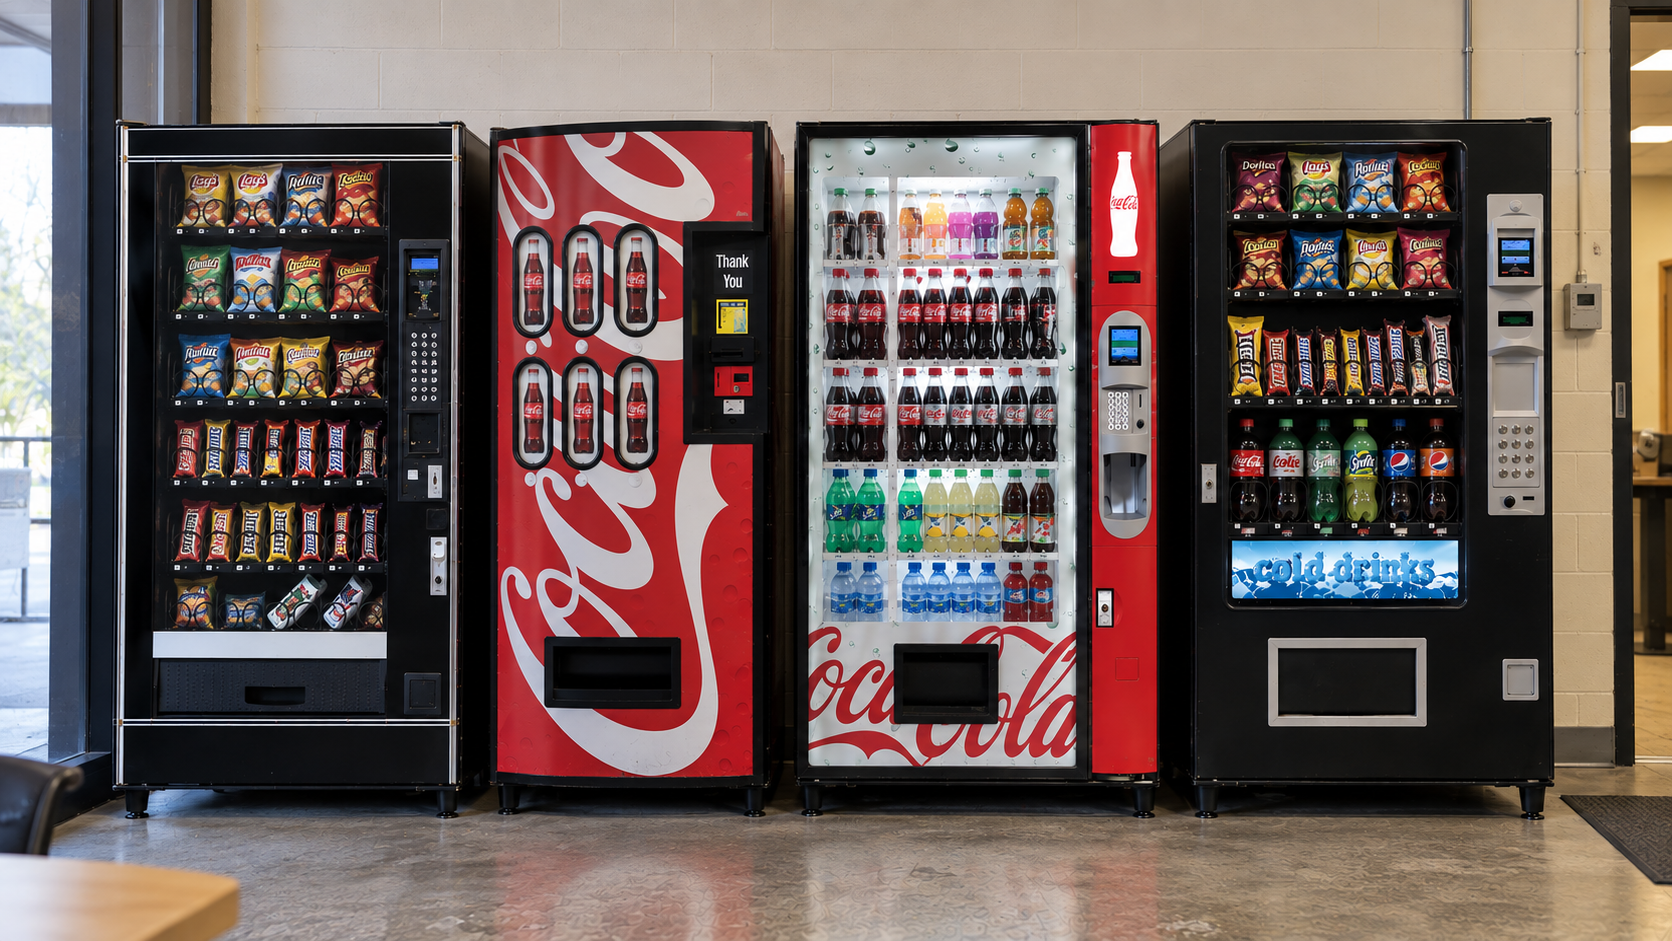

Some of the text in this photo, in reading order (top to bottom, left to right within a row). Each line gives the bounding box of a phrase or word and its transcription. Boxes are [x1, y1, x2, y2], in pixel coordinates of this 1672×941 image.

[715, 253, 749, 269] Thank
[723, 273, 743, 289] You
[1253, 551, 1435, 585] cold drinks
